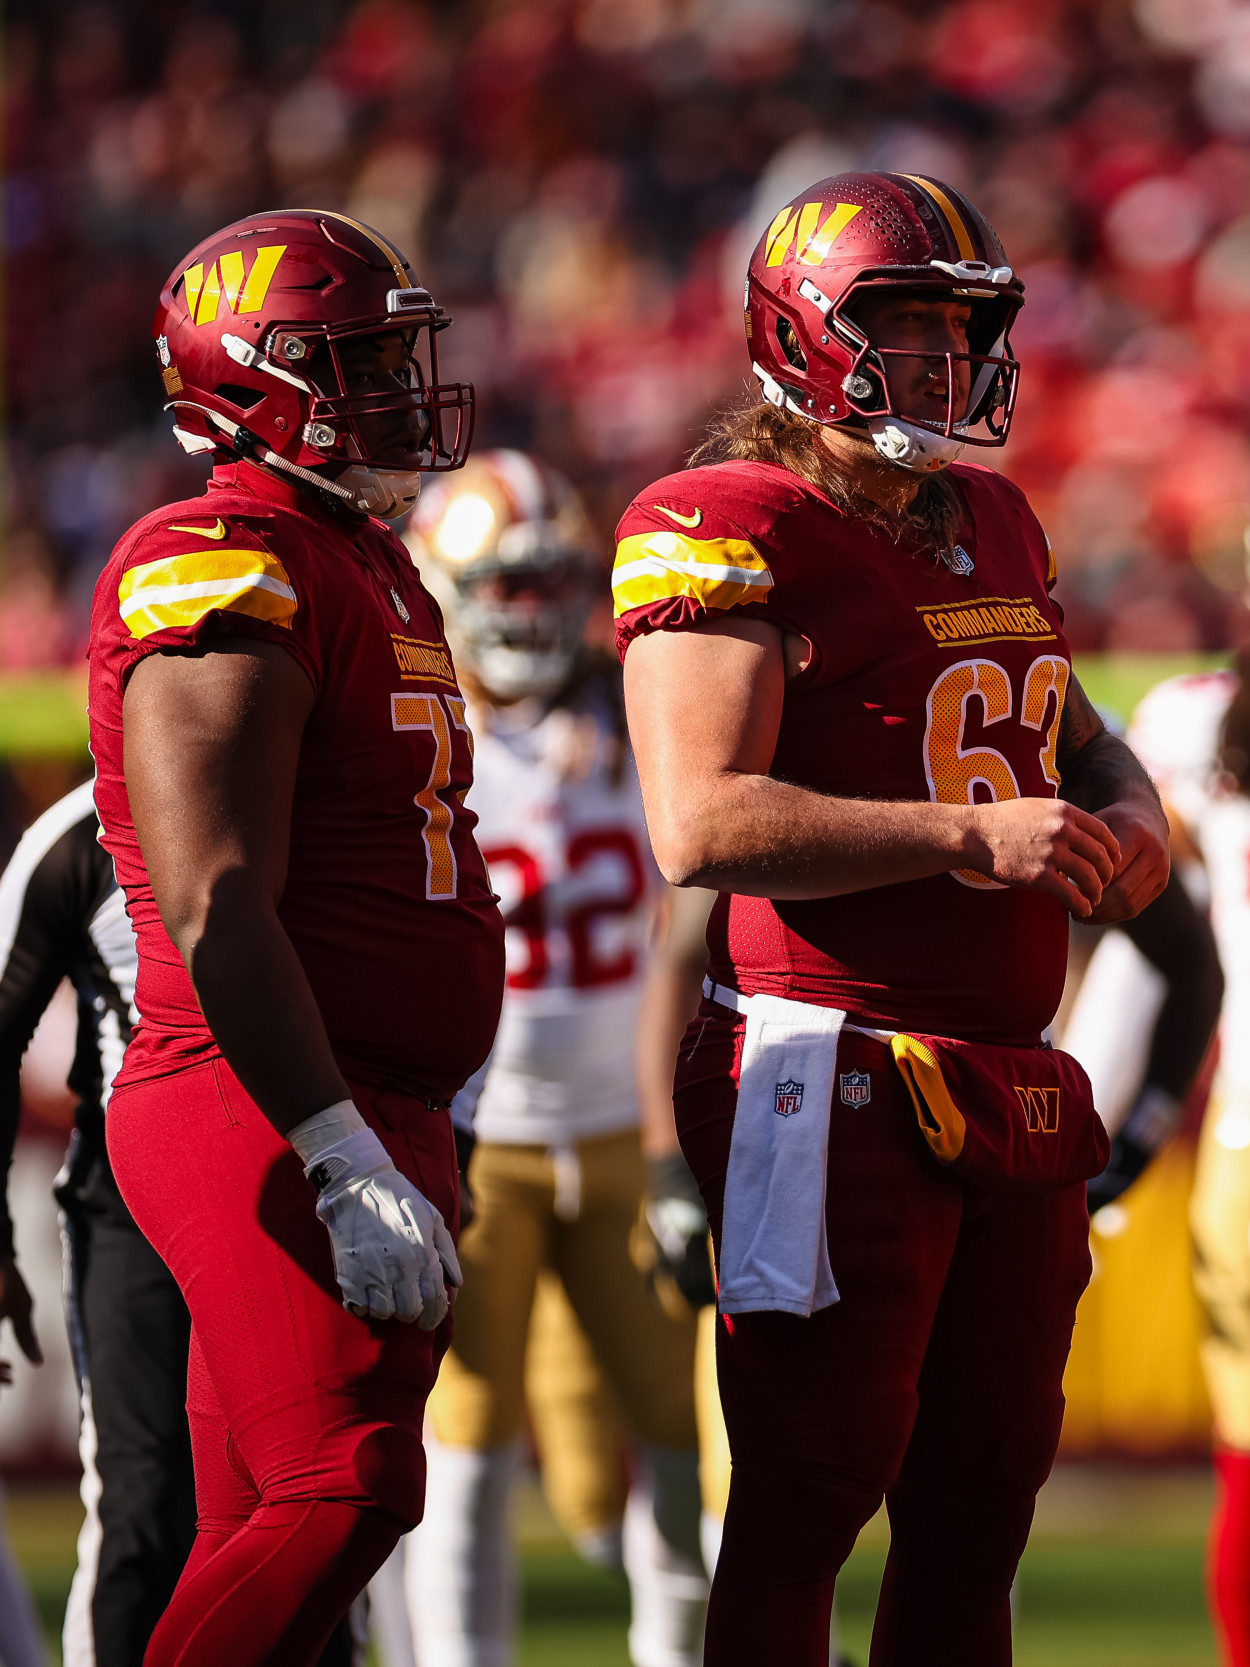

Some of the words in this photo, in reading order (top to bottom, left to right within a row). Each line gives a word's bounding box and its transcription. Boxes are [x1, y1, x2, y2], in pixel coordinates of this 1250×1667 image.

[923, 605, 1052, 641] COMMANDERS
[845, 1086, 866, 1102] NFL
[776, 1095, 800, 1114] NFL
